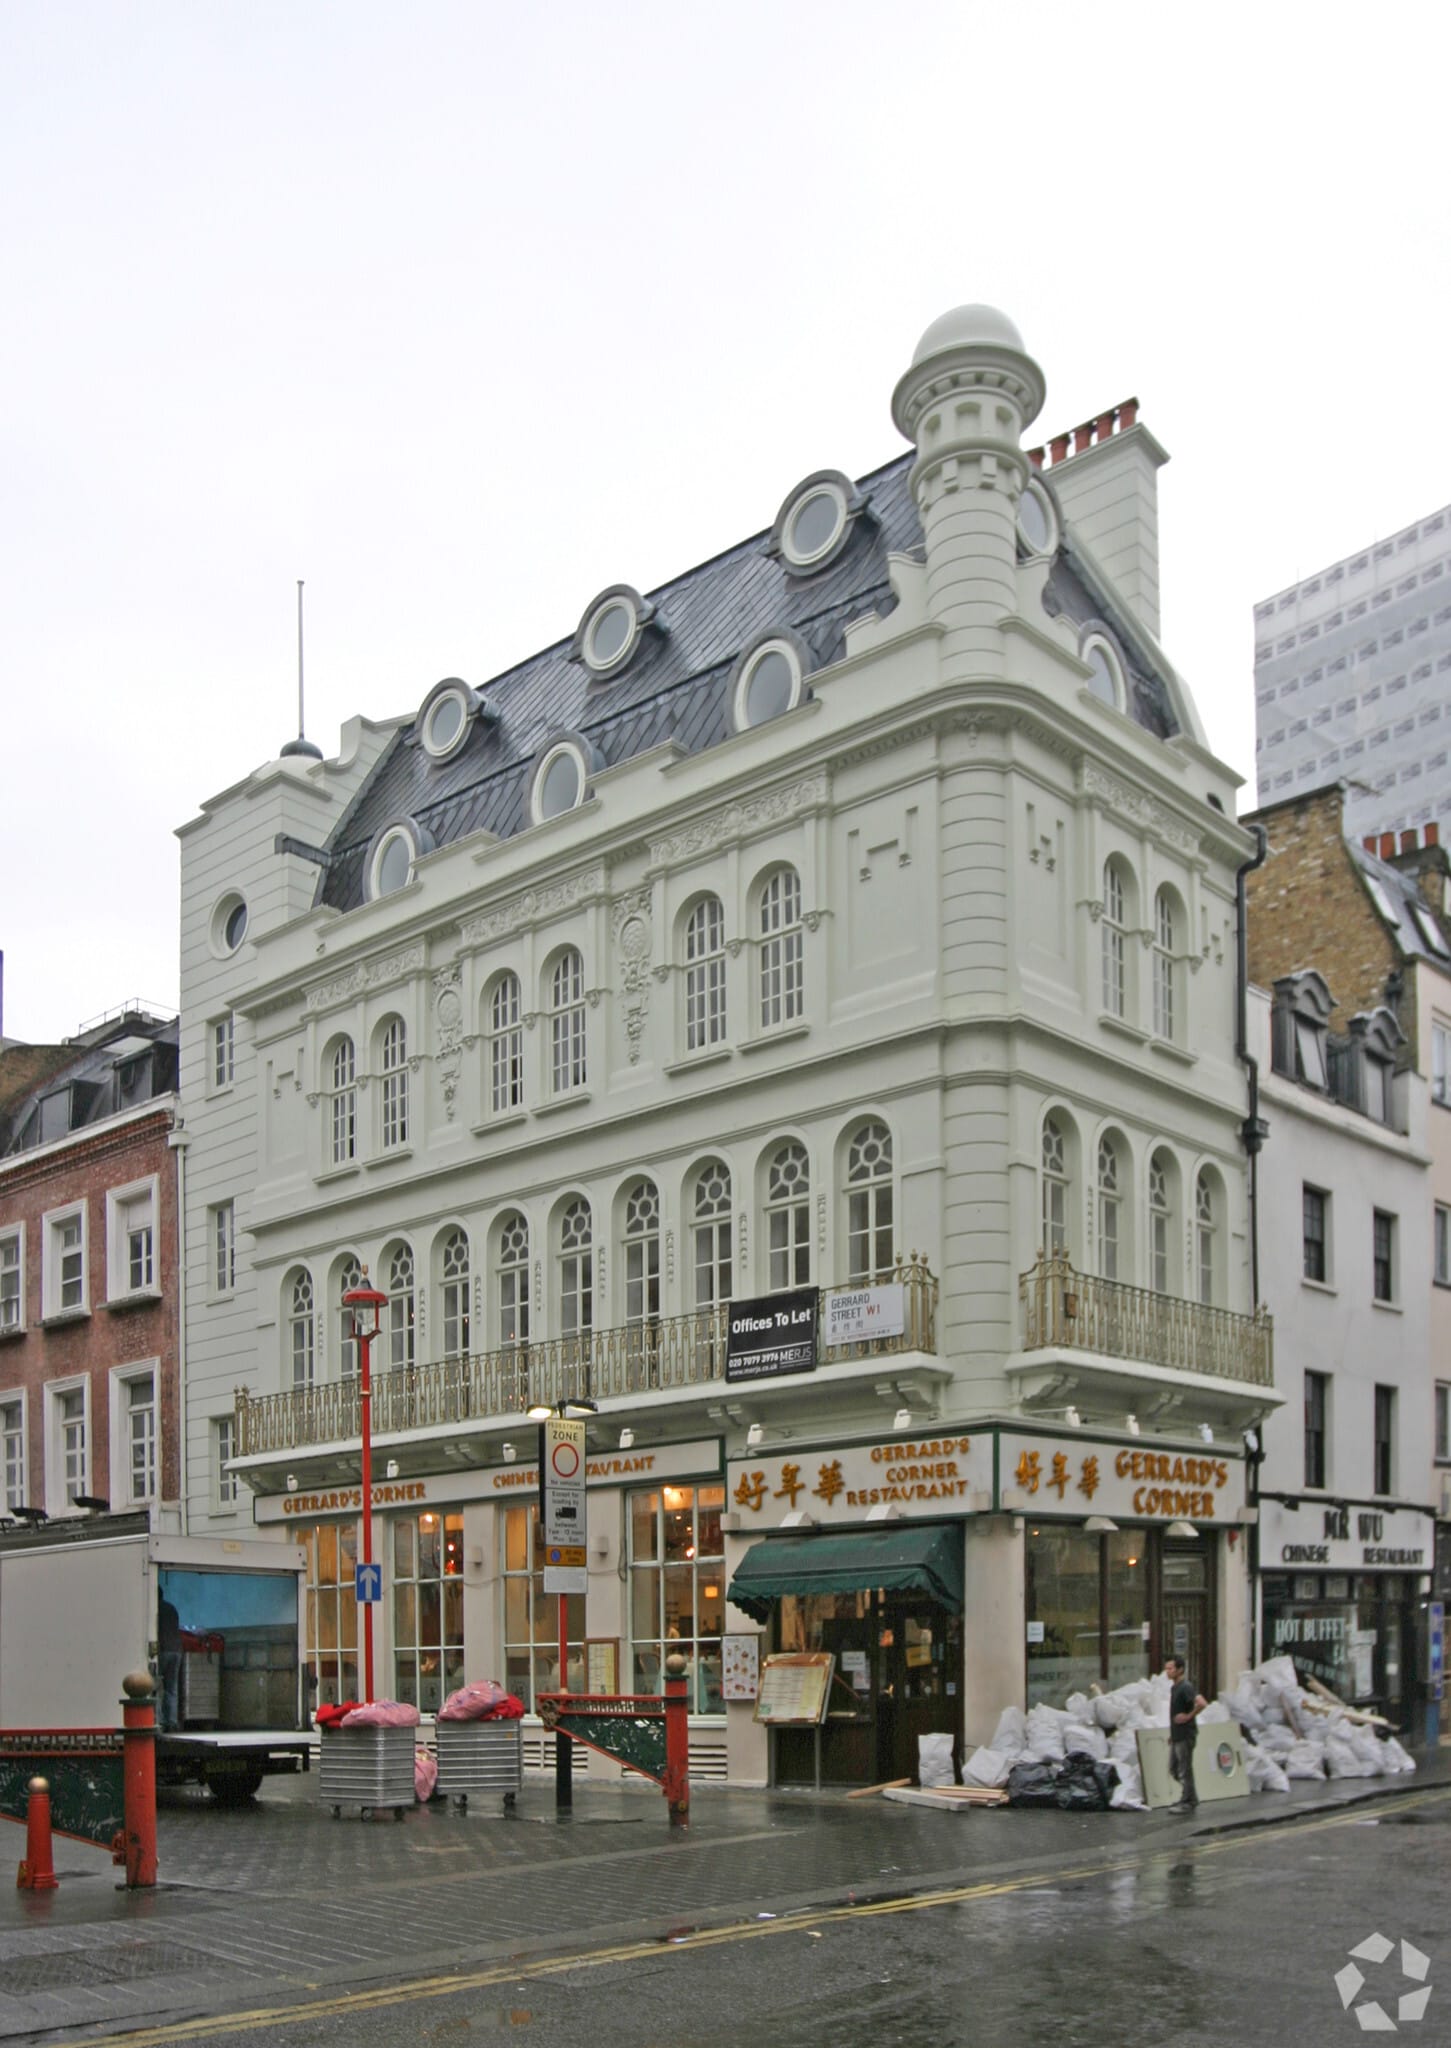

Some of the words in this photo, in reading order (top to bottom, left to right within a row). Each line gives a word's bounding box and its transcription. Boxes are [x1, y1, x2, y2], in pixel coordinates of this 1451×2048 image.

[831, 1293, 870, 1310] GERRARD
[831, 1307, 862, 1322] STREET
[866, 1304, 880, 1316] W1
[732, 1318, 773, 1334] Offices
[774, 1312, 789, 1327] To
[791, 1308, 811, 1325] Let
[728, 1357, 742, 1368] 020
[743, 1356, 760, 1366] 7079
[780, 1347, 812, 1361] MERJS
[552, 1431, 579, 1442] ZONE
[871, 1437, 970, 1463] GERRARD'S
[886, 1462, 958, 1483] CORNER
[1015, 1450, 1100, 1501] 好年華
[1114, 1449, 1229, 1489] GERRARD'S
[733, 1459, 846, 1511] 好年華
[283, 1489, 362, 1514] GERRARD'S
[1133, 1486, 1215, 1518] CORNER
[1324, 1508, 1349, 1540] MR
[1358, 1513, 1383, 1542] WU
[1281, 1544, 1330, 1564] CHINESE
[1363, 1547, 1425, 1566] RESTAURANT
[1274, 1618, 1300, 1642] HOT
[1303, 1617, 1345, 1641] BUFFET
